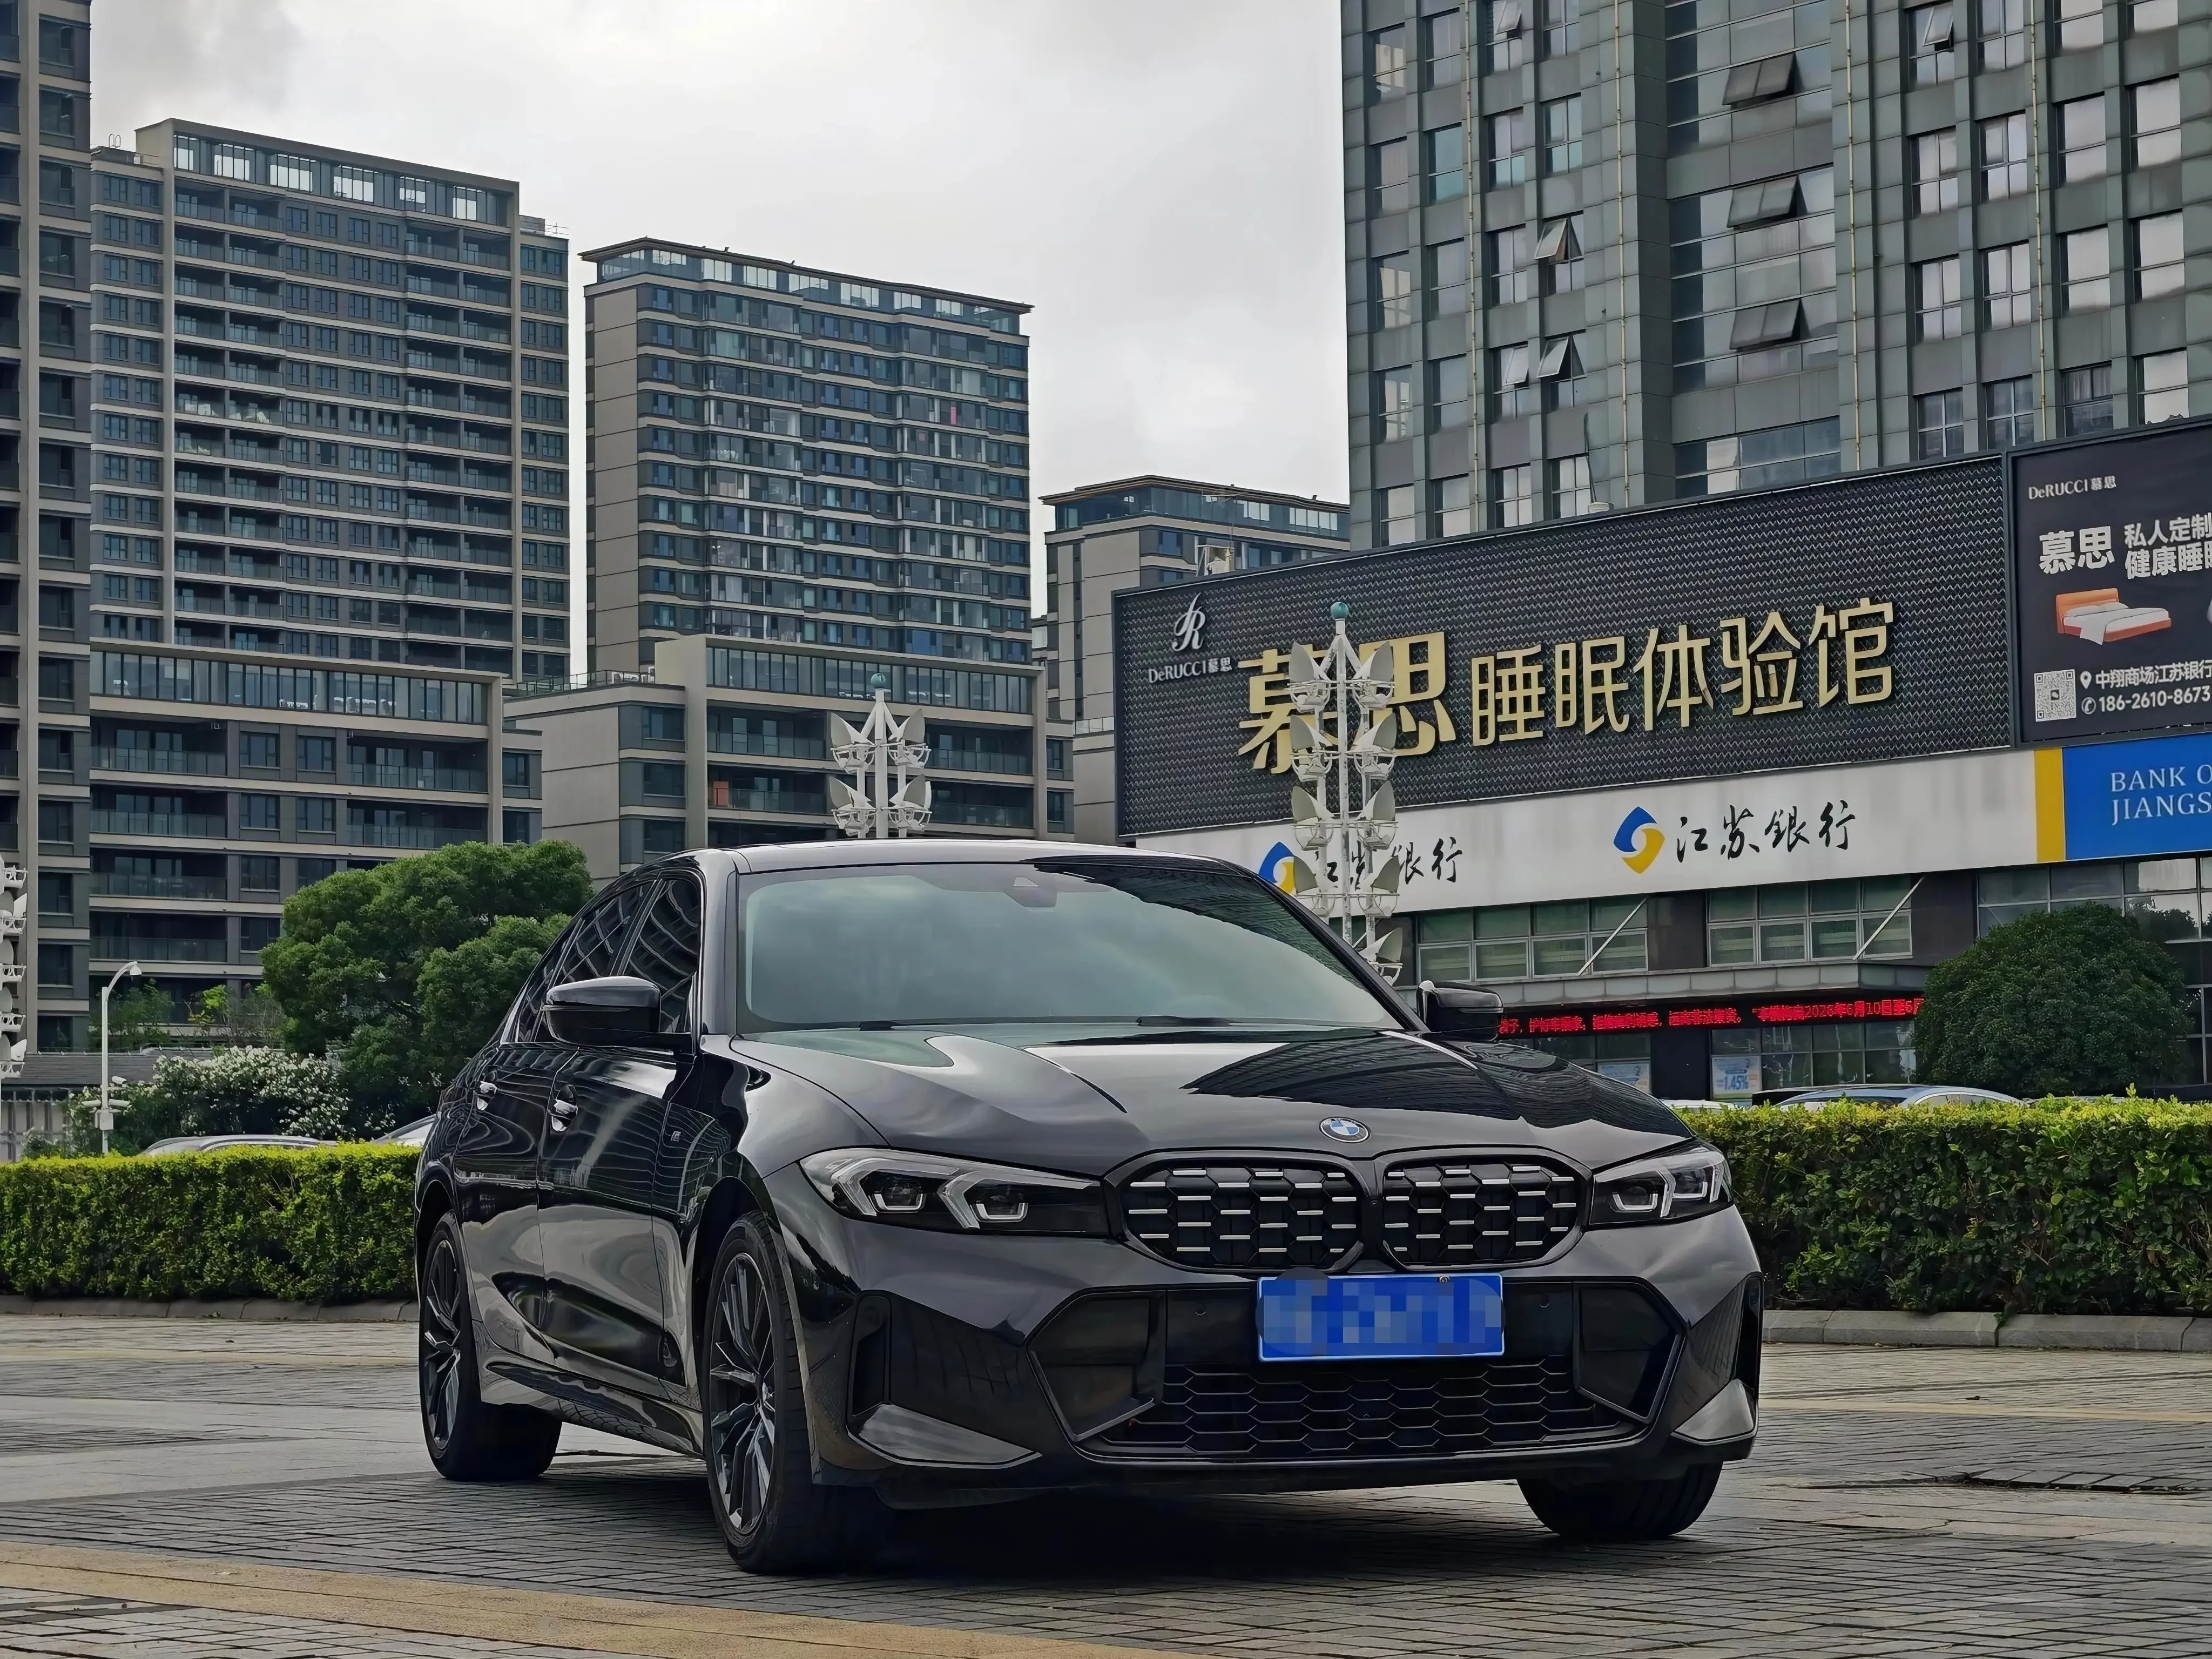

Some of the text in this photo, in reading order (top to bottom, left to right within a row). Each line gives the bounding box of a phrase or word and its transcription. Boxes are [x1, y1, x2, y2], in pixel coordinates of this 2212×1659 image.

[2028, 475, 2116, 500] DeRUCCI 慕思
[2124, 511, 2212, 549] 私人定制
[2039, 525, 2115, 575] 慕思
[1148, 660, 1206, 683] DeRUCCI
[2095, 659, 2212, 690] 中翔商场江苏银行
[2099, 685, 2211, 712] 186-2610-8673
[2110, 766, 2187, 792] BANK
[2112, 791, 2212, 826] JIANGS
[1677, 800, 1856, 863] 江苏银行
